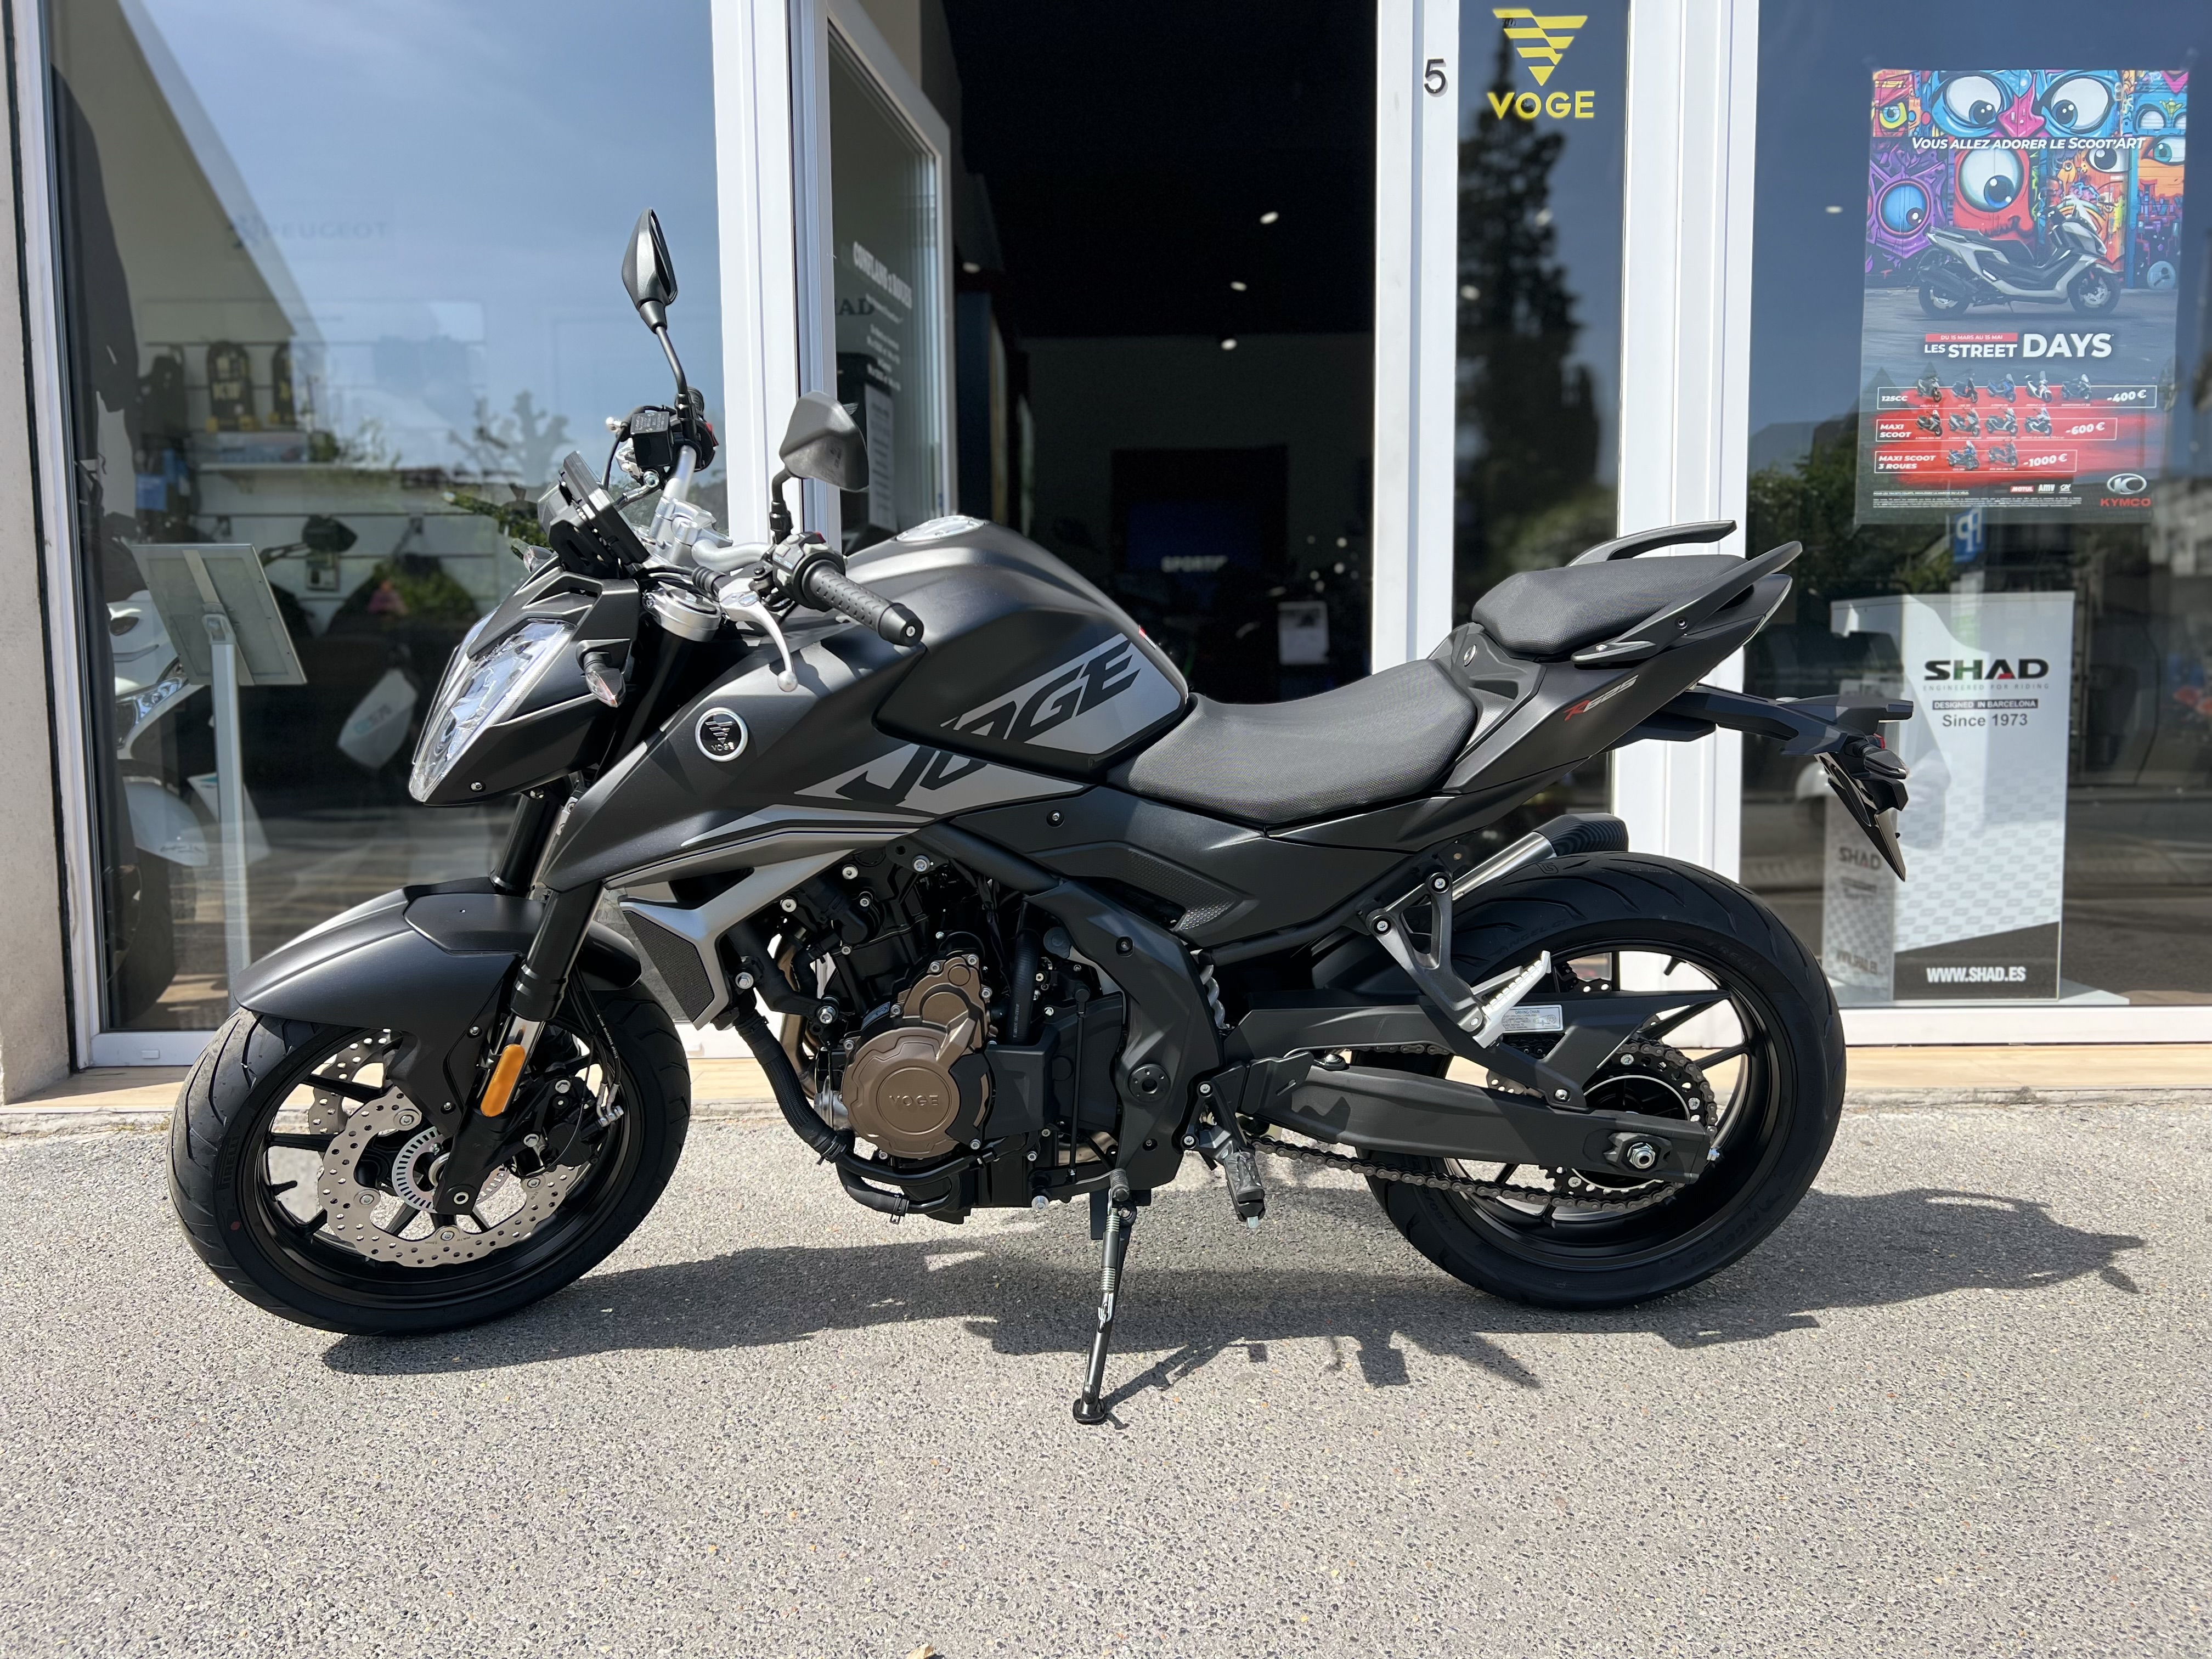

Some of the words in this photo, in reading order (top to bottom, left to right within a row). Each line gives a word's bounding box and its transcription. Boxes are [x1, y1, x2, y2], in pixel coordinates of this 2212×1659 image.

[1424, 59, 1446, 93] 5
[1487, 91, 1594, 119] VOGE
[1912, 138, 1948, 149] VOUS
[1950, 139, 1989, 149] ALLEZ
[1993, 139, 2046, 149] ADORER
[2050, 139, 2066, 149] LE
[1925, 345, 1946, 353] LES
[1948, 344, 2018, 358] STREET
[2023, 334, 2112, 357] DAYS
[2100, 498, 2151, 507] KYMCO
[1925, 659, 2049, 680] SHAD
[1942, 714, 1985, 727] Since
[1992, 714, 2028, 726] 1973
[1839, 847, 1882, 870] SHAD
[1927, 966, 2025, 983] WWW.SHAD.ES
[889, 1095, 939, 1107] VOGE
